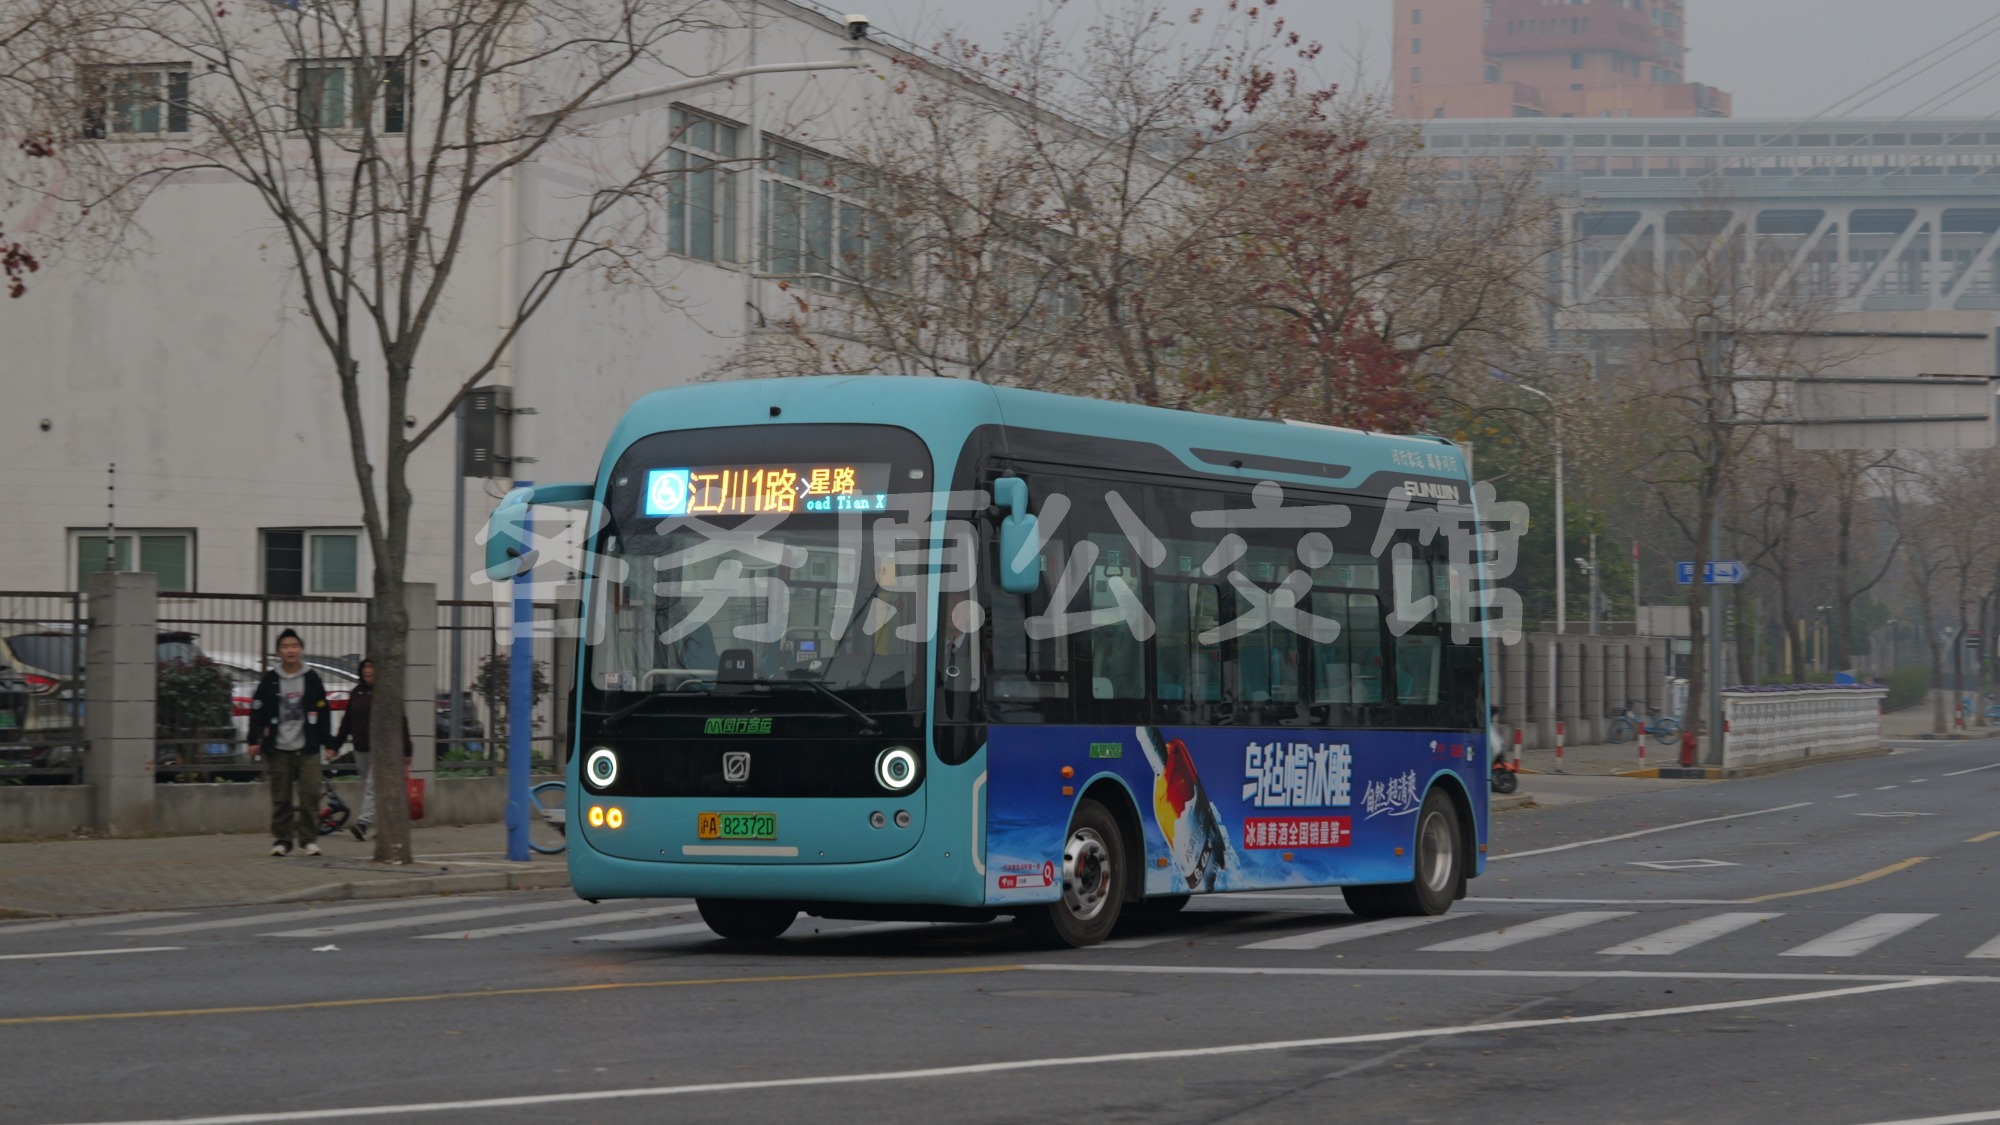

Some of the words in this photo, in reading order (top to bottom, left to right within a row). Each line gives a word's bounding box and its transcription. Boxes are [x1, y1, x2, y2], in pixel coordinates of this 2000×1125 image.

[686, 468, 798, 514] 江川1路
[808, 467, 855, 495] 星路
[1403, 480, 1460, 501] SUNWIN
[806, 497, 831, 510] oad
[837, 496, 870, 510] Tian
[875, 494, 885, 509] X
[722, 717, 773, 734] 闵行客运
[1242, 741, 1352, 808] 乌毡帽冰雕
[724, 817, 774, 835] 82372D
[1245, 820, 1350, 847] 冰雕黄酒全国销量第一
